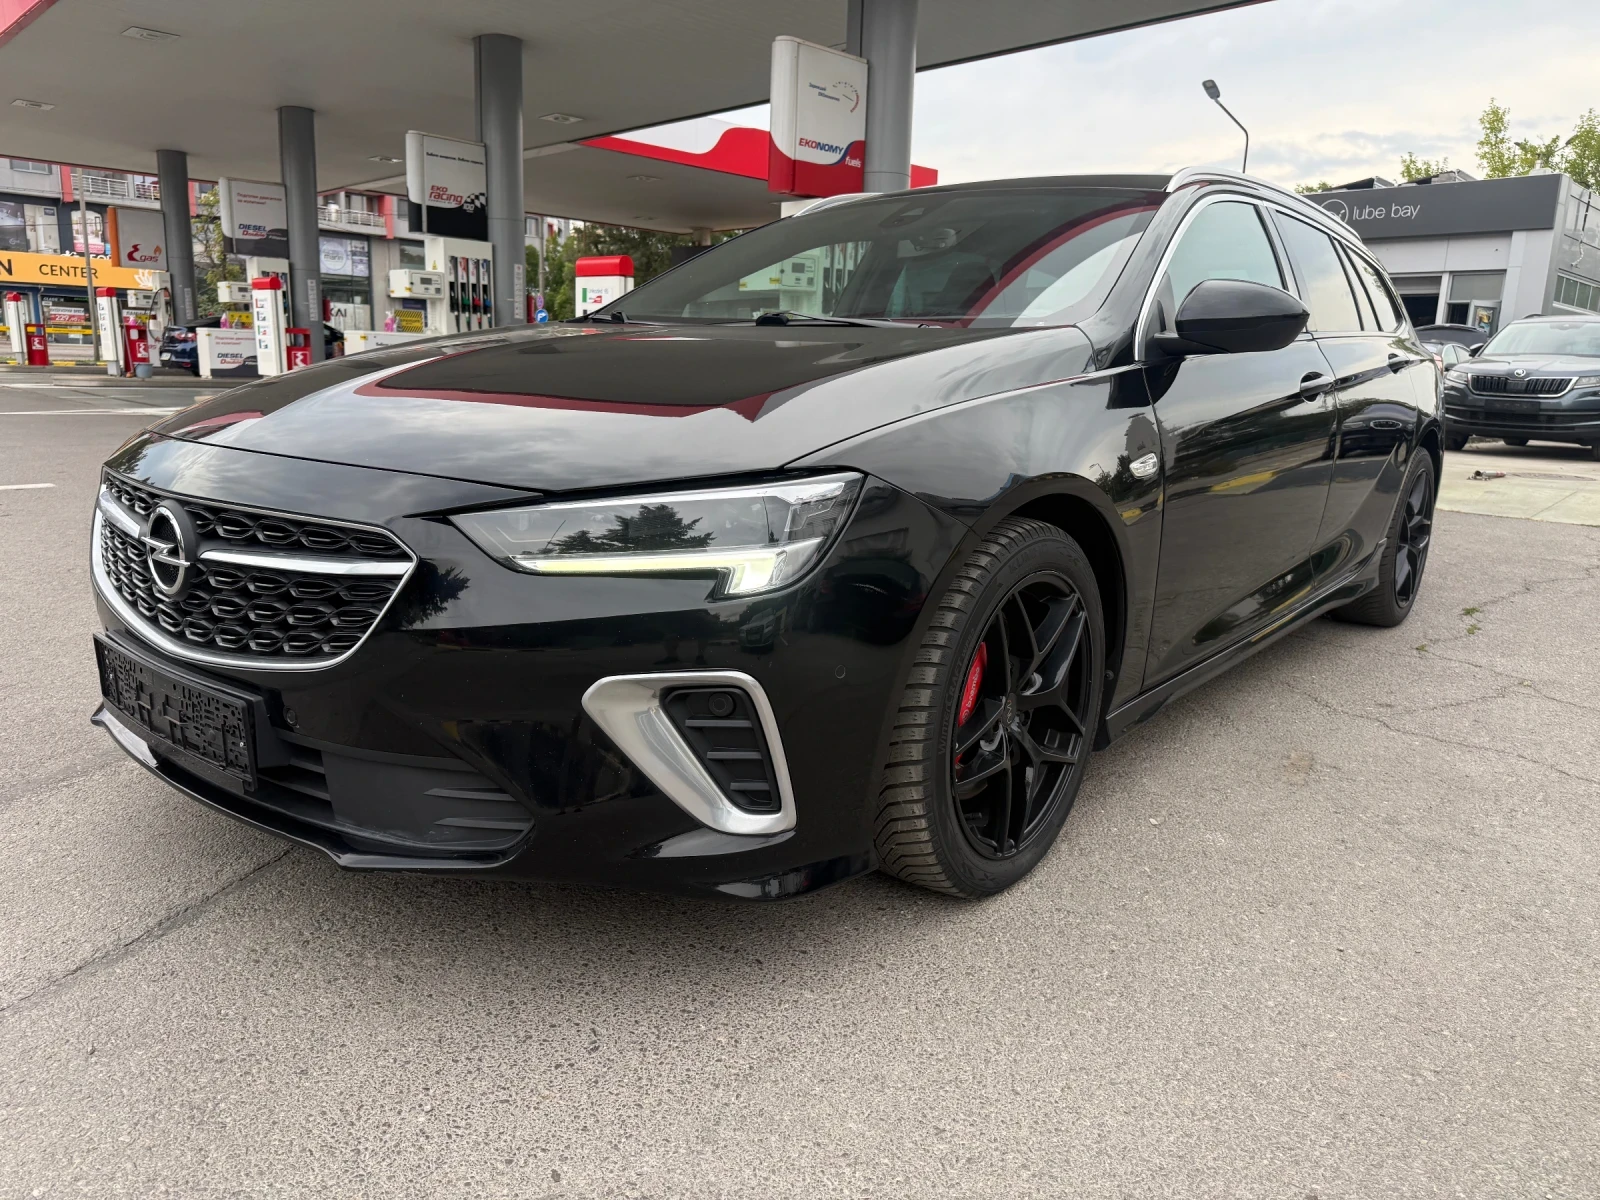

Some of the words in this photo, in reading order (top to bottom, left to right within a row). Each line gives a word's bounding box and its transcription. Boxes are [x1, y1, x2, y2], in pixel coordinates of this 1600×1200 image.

[798, 137, 844, 155] EKONOMY
[845, 156, 862, 168] fuels
[430, 185, 448, 193] EKO
[429, 191, 463, 206] racing
[1352, 205, 1386, 220] lube
[1391, 203, 1421, 219] bay
[238, 223, 267, 232] DIESEL
[39, 263, 98, 279] CENTER
[966, 667, 980, 707] brembo
